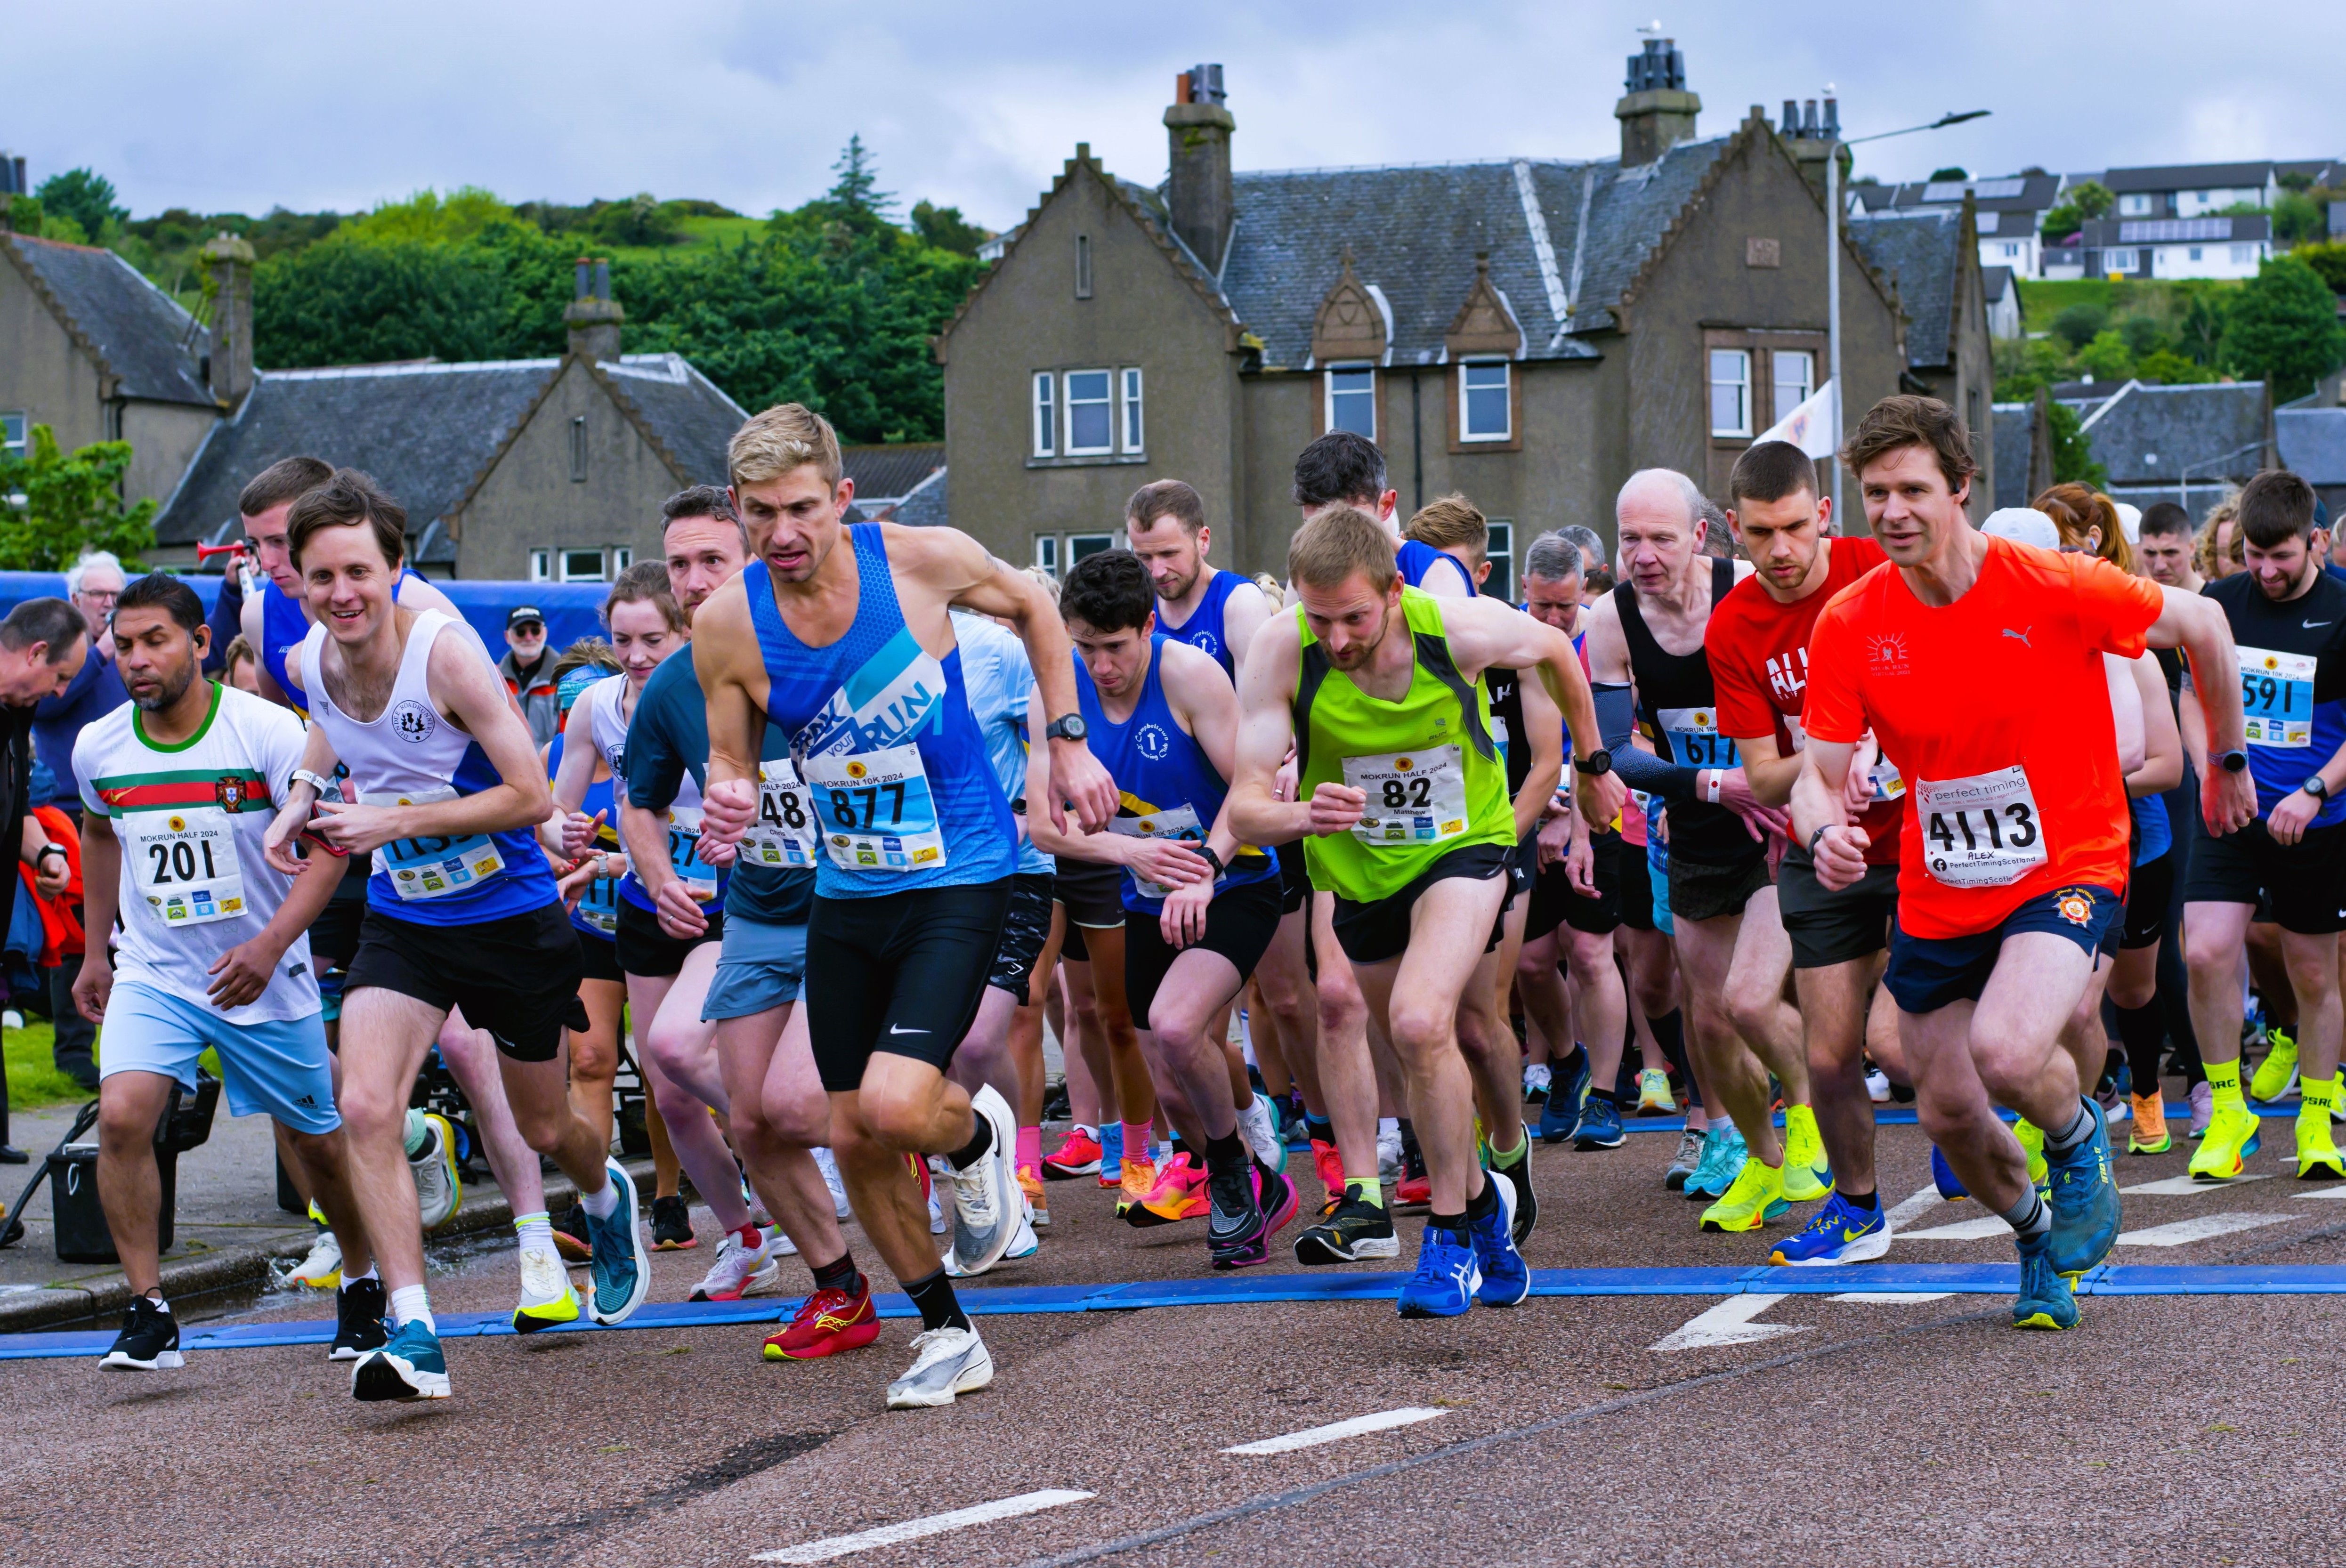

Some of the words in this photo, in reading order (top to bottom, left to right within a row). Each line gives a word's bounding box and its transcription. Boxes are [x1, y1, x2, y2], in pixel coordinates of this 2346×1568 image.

[2240, 666, 2270, 676] MOKRUN
[2242, 675, 2292, 713] 591
[393, 711, 409, 740] DUNDEE
[399, 702, 433, 735] ROADRUNNERS
[1135, 723, 1169, 742] Campbeltown
[1428, 730, 1447, 740] RUN
[1159, 743, 1168, 758] Club
[1685, 734, 1736, 765] 677
[1360, 771, 1401, 780] MOKRUN
[1403, 769, 1427, 778] HALF
[1429, 762, 1448, 775] 2024
[782, 781, 801, 790] 2024
[819, 778, 860, 788] MOKRUN
[862, 776, 880, 786] 10K
[882, 772, 904, 783] 2024
[1383, 777, 1432, 808] 82
[1934, 787, 1980, 801] perfect
[1984, 777, 2025, 794] timing
[753, 791, 806, 829] 48
[830, 782, 906, 829] 877
[684, 826, 700, 834] 2024
[1167, 826, 1185, 835] 2024
[1930, 802, 2036, 851] 4113
[140, 833, 176, 842] MOKRUN
[178, 831, 198, 839] HALF
[149, 840, 216, 884] 201
[1950, 856, 2036, 869] PerfectTimingScotland
[1967, 851, 1995, 860] ALEX
[2209, 1078, 2235, 1089] SRC
[292, 1101, 319, 1109] adidas
[2302, 1096, 2331, 1108] PSRC
